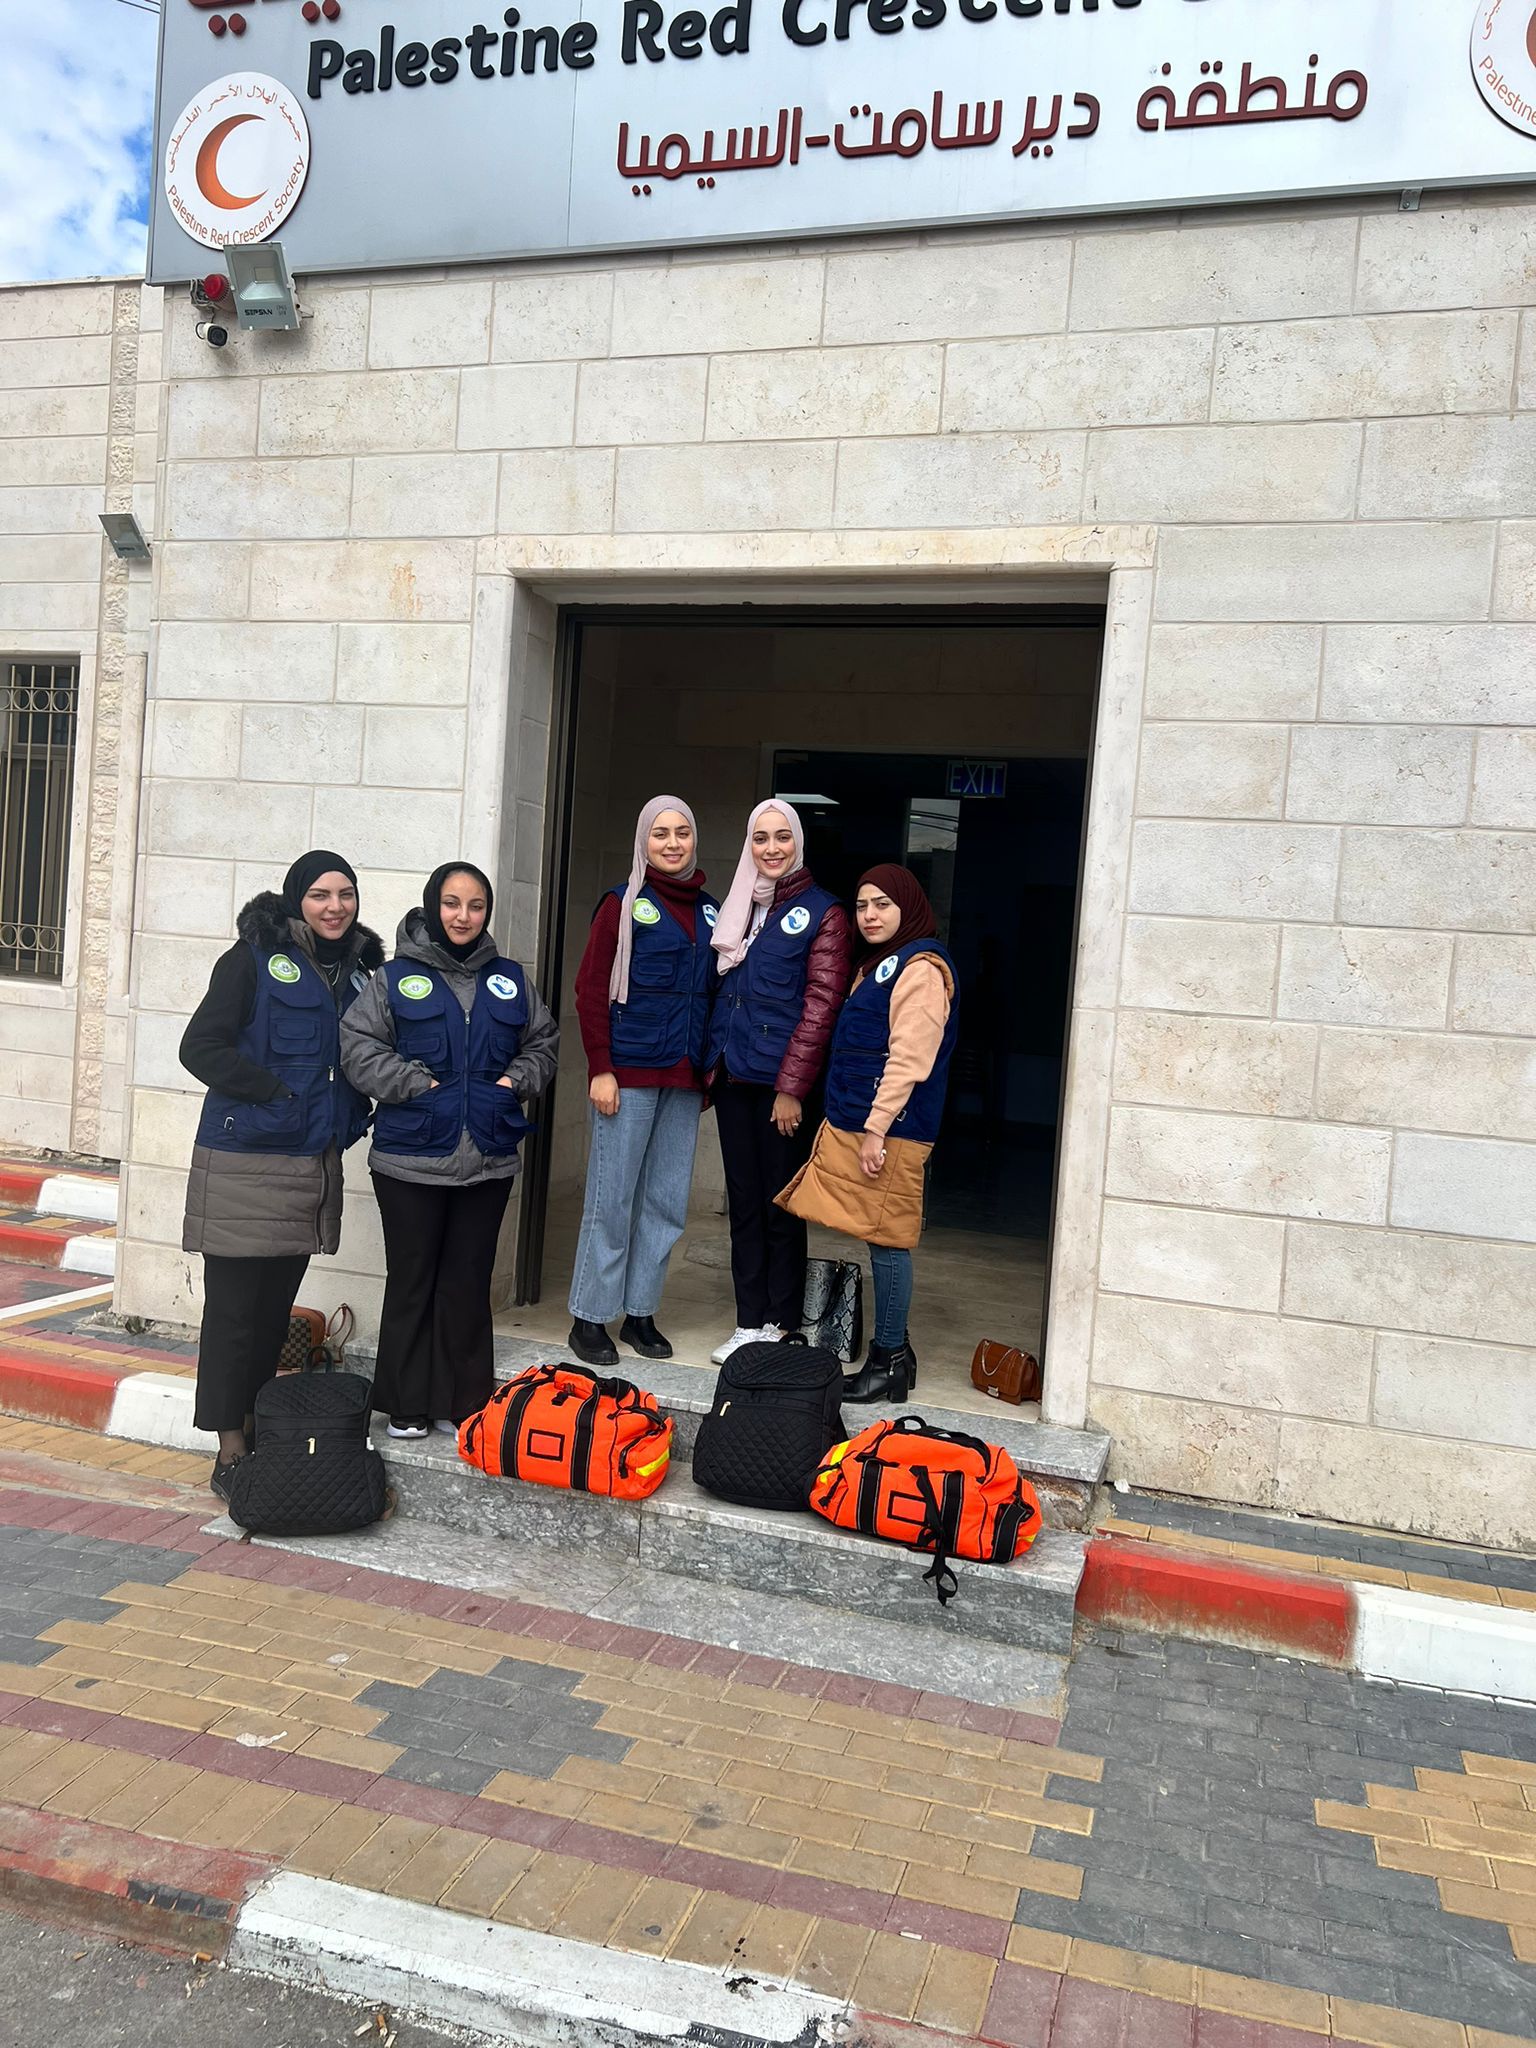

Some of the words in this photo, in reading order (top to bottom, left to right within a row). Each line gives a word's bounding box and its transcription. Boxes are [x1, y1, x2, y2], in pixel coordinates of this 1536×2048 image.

[306, 8, 598, 101] Palestine
[622, 0, 753, 66] Red
[246, 84, 278, 105] الهلال
[1012, 92, 1101, 158] دير
[1137, 54, 1367, 132] منطقة
[168, 184, 208, 239] Palestine
[210, 227, 230, 245] Red
[233, 211, 276, 245] Crescent
[273, 155, 306, 216] Society
[950, 762, 1005, 794] EXIT
